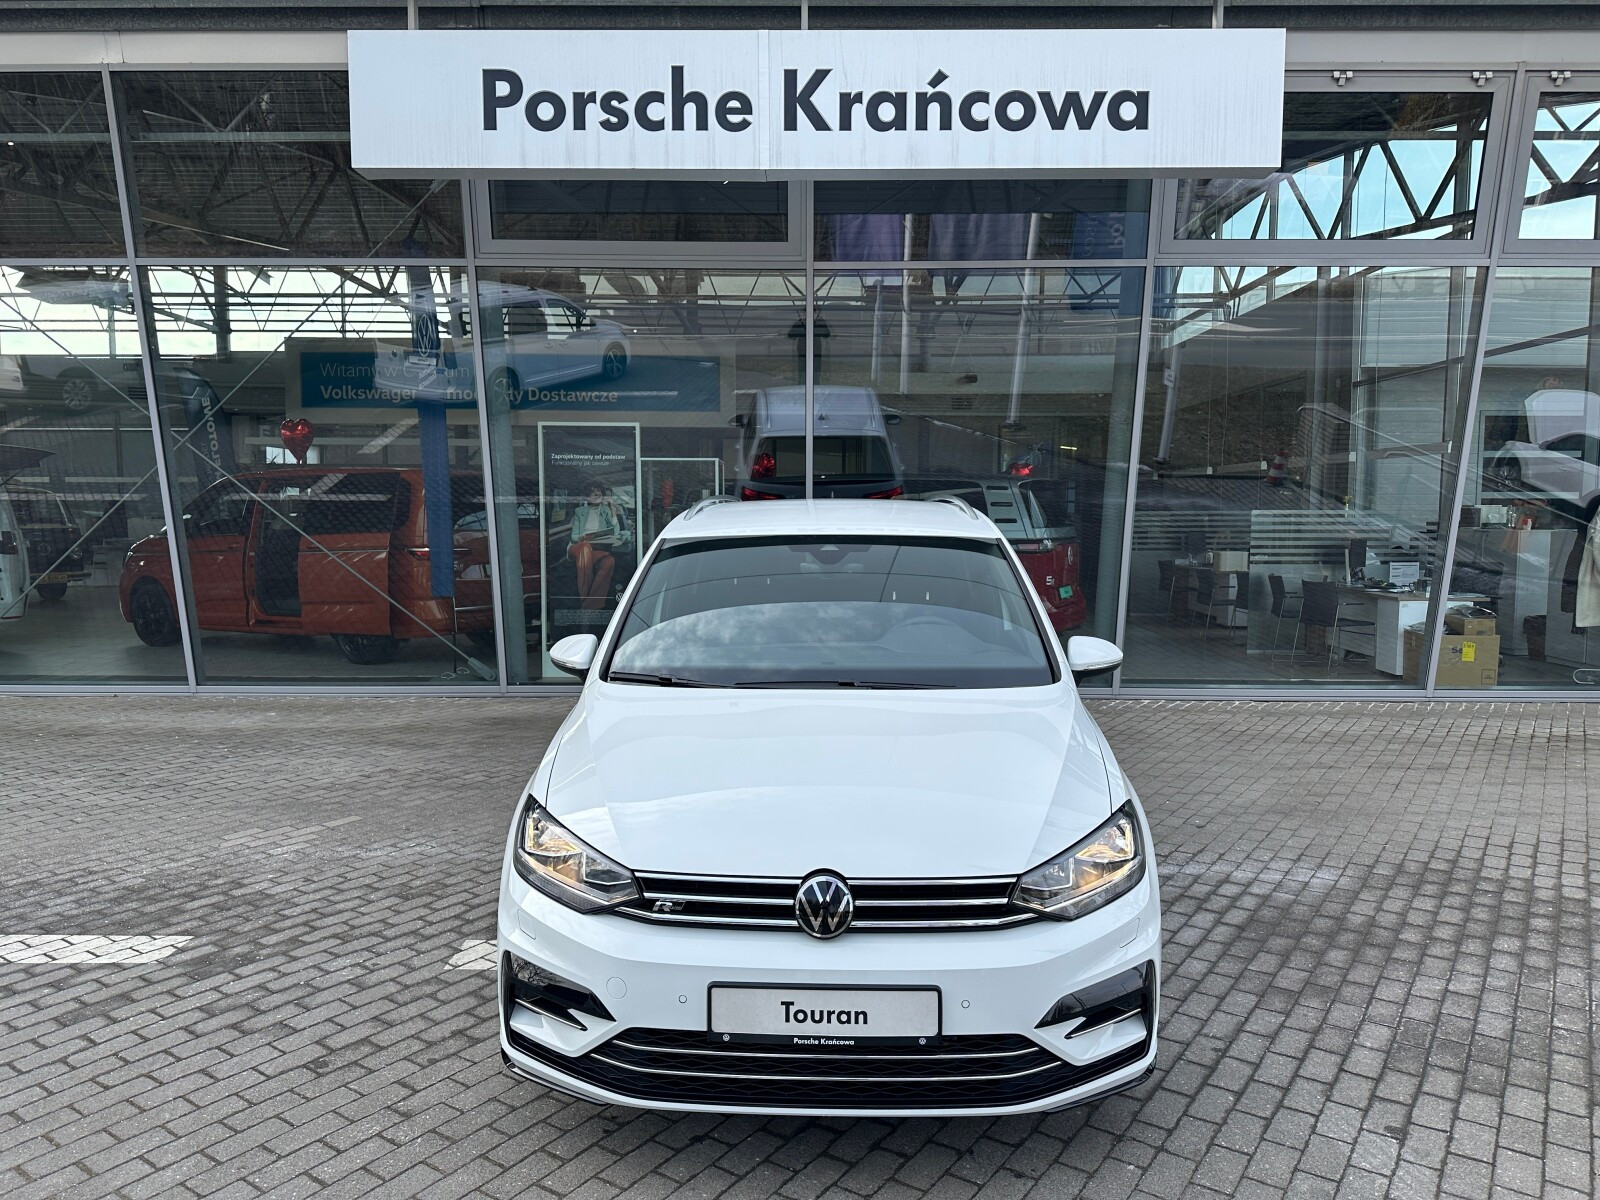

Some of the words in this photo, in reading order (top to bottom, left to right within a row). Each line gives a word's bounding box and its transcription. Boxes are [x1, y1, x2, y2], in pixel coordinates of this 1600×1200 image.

[482, 65, 753, 132] Porsche
[783, 68, 1150, 132] Krańcowa
[320, 362, 378, 380] Witamy
[528, 387, 618, 402] Dostawcze
[780, 1001, 868, 1025] Touran
[793, 1037, 819, 1045] Porsche
[820, 1038, 855, 1046] Krańcowa
